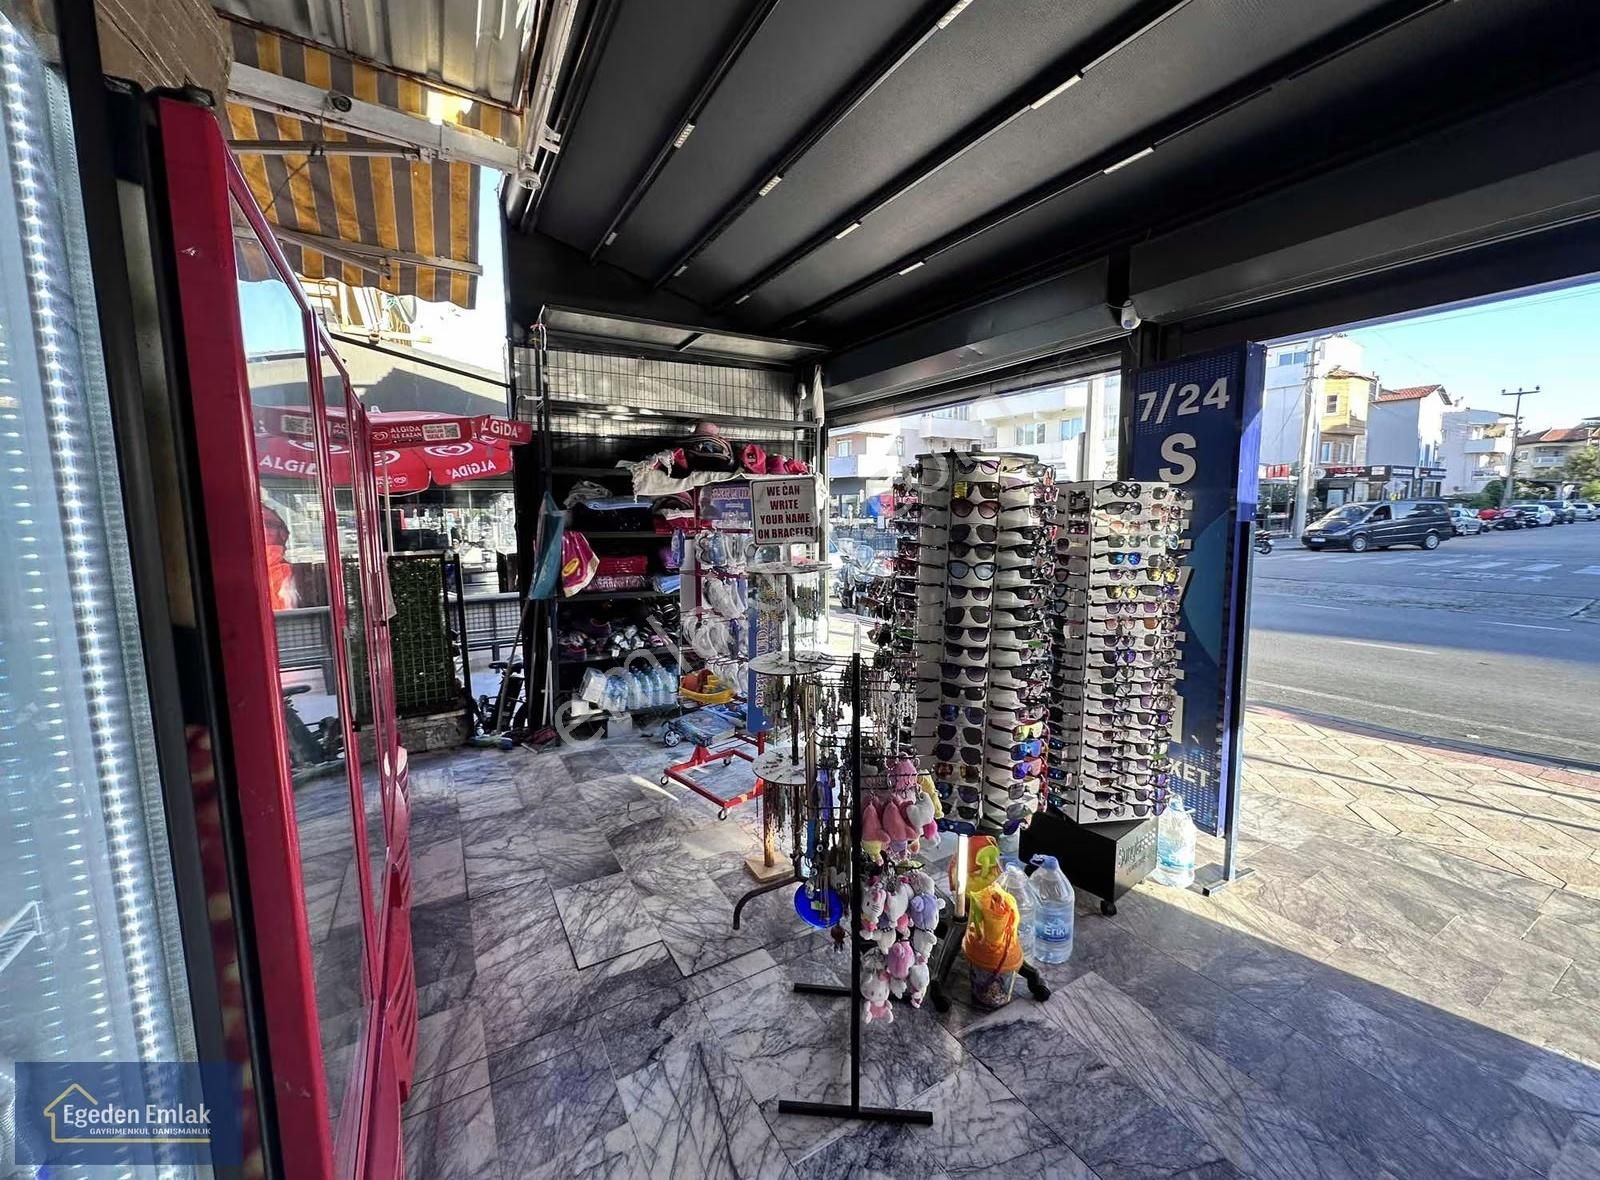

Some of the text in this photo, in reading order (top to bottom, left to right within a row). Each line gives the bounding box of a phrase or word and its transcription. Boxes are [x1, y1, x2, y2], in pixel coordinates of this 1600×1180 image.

[1138, 377, 1230, 424] 7/24
[766, 485, 800, 496] WE CAN
[769, 499, 799, 510] WRITE
[759, 514, 784, 525] YOUR
[785, 512, 810, 524] NAME
[757, 529, 770, 540] ON
